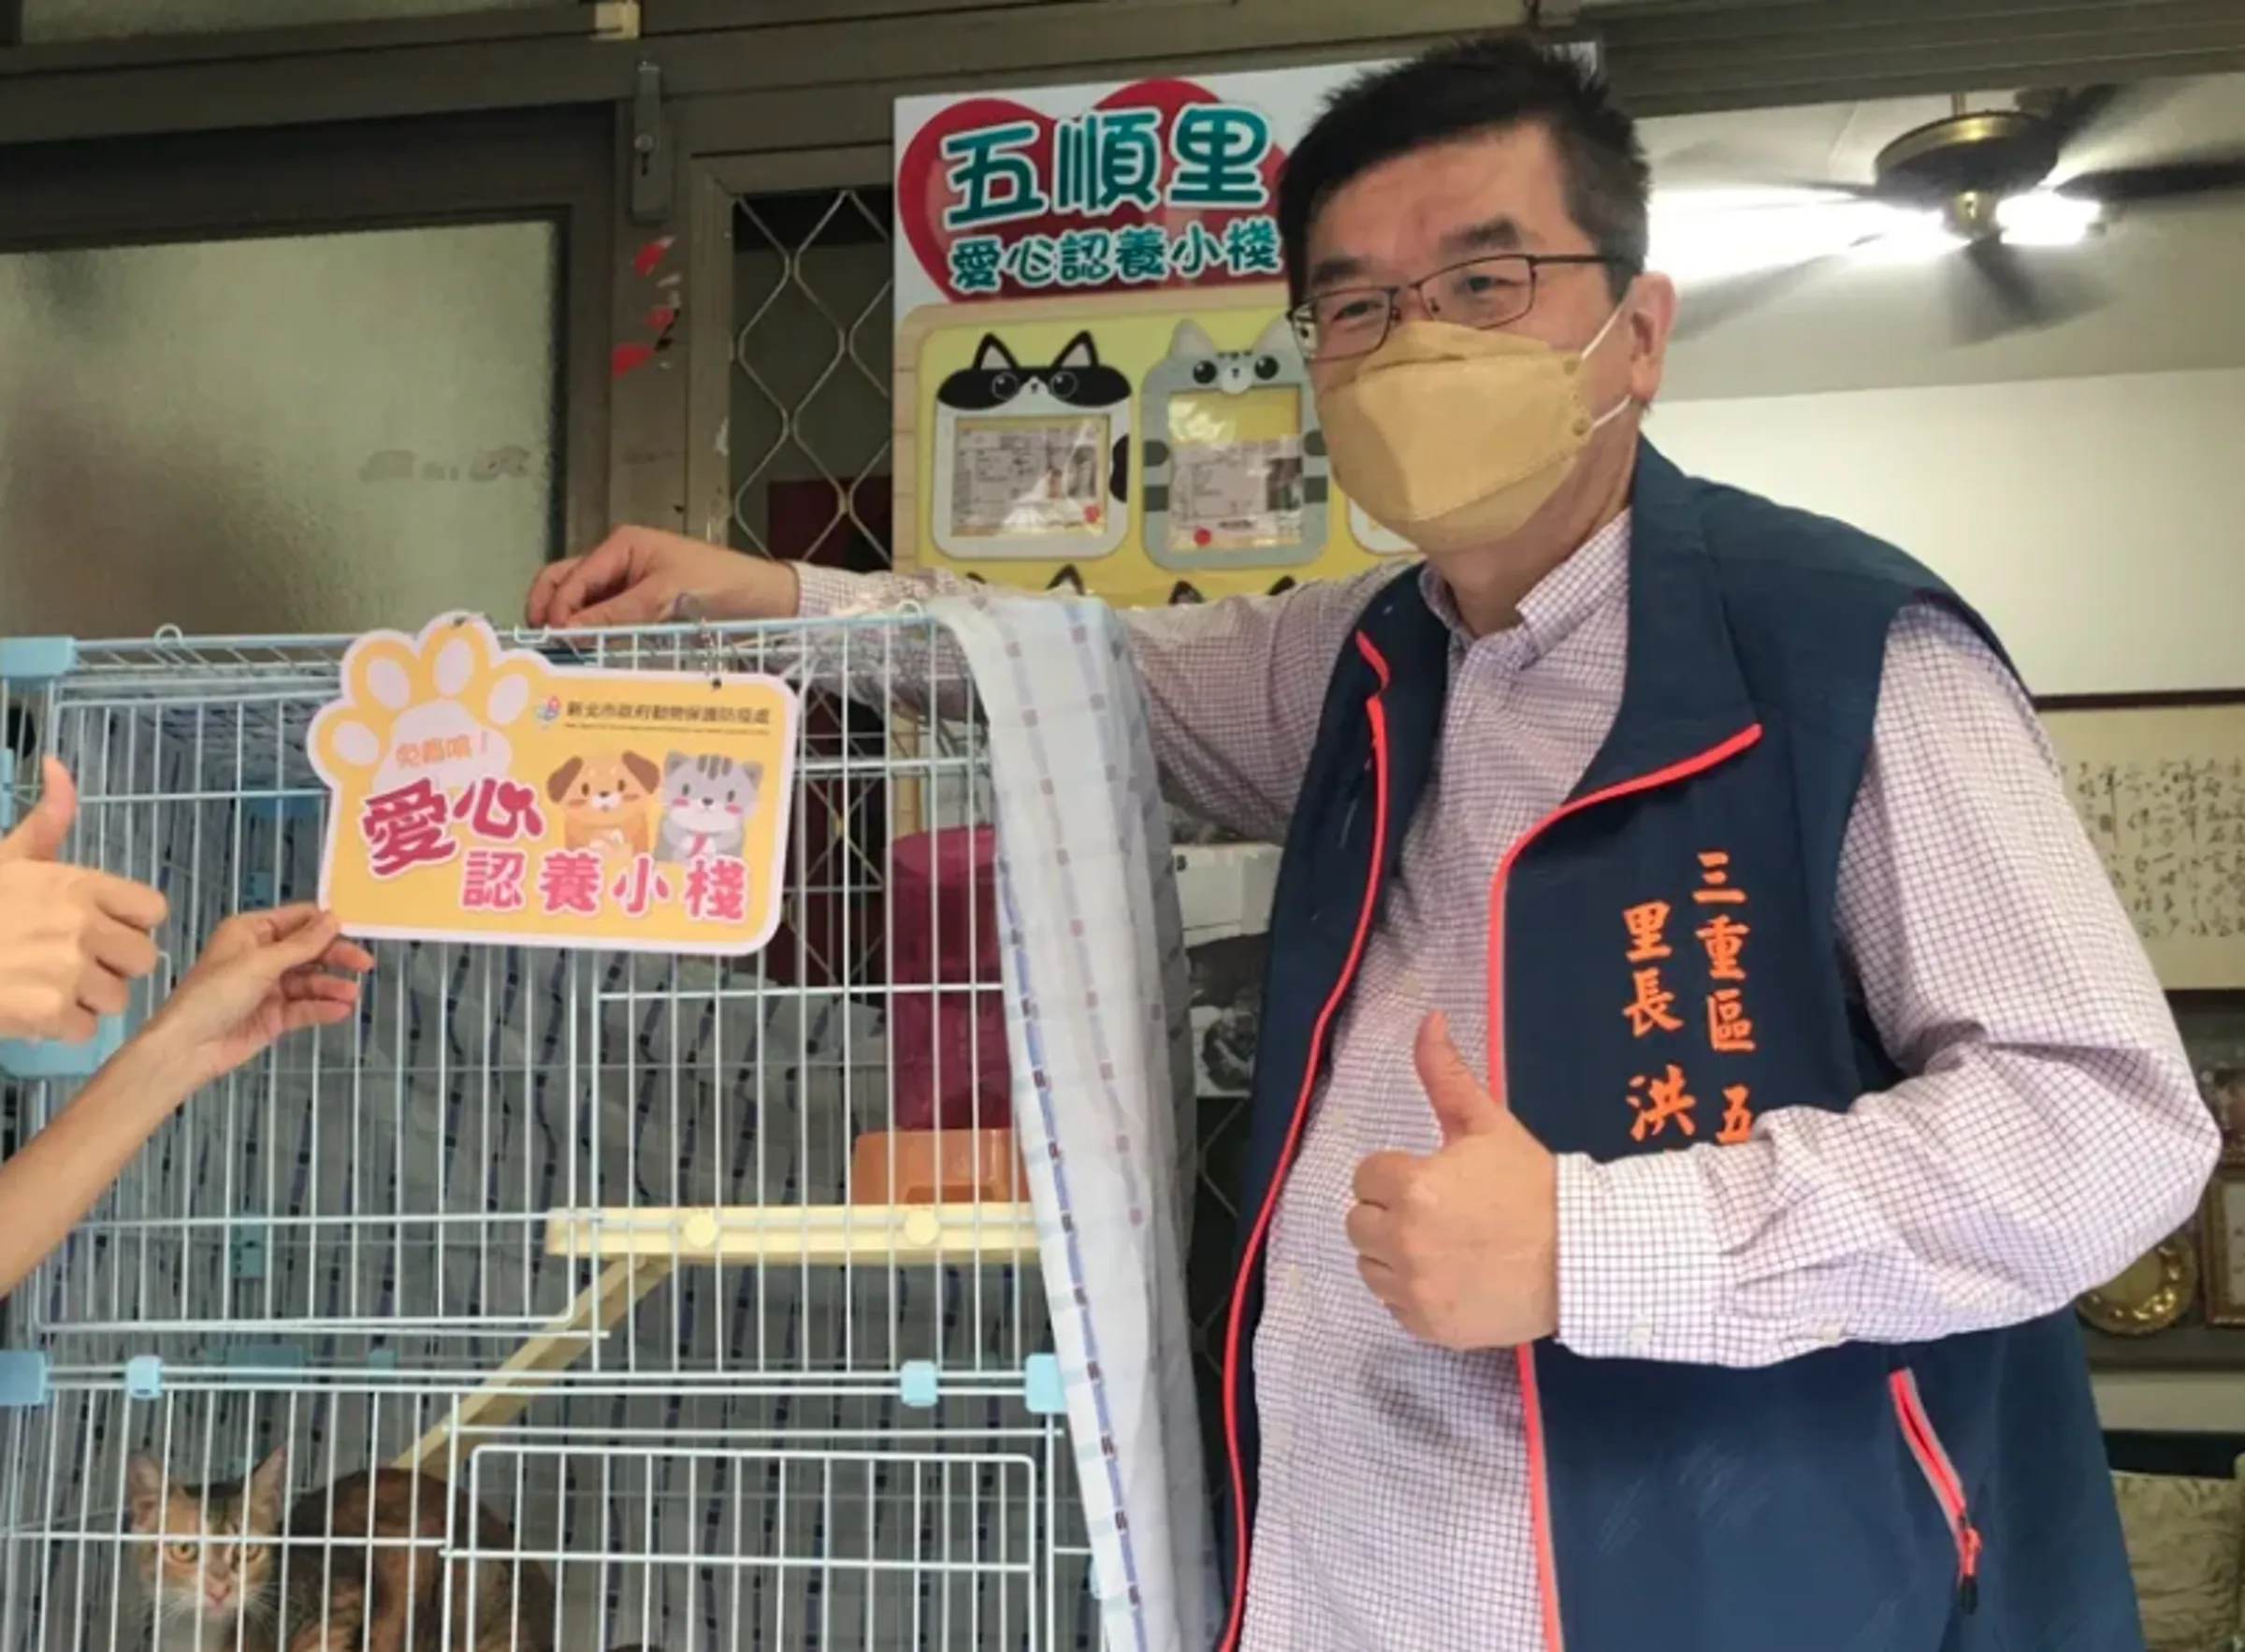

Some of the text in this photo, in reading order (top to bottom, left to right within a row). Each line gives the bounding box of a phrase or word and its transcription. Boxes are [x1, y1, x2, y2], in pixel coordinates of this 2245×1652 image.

[946, 107, 1268, 225] 五順里
[950, 219, 1280, 289] 愛心認養小棧
[362, 777, 544, 875] 愛心
[462, 849, 746, 921] 認養小棧
[1692, 851, 1756, 1051] 三重區
[1622, 900, 1697, 1141] 里長 洪
